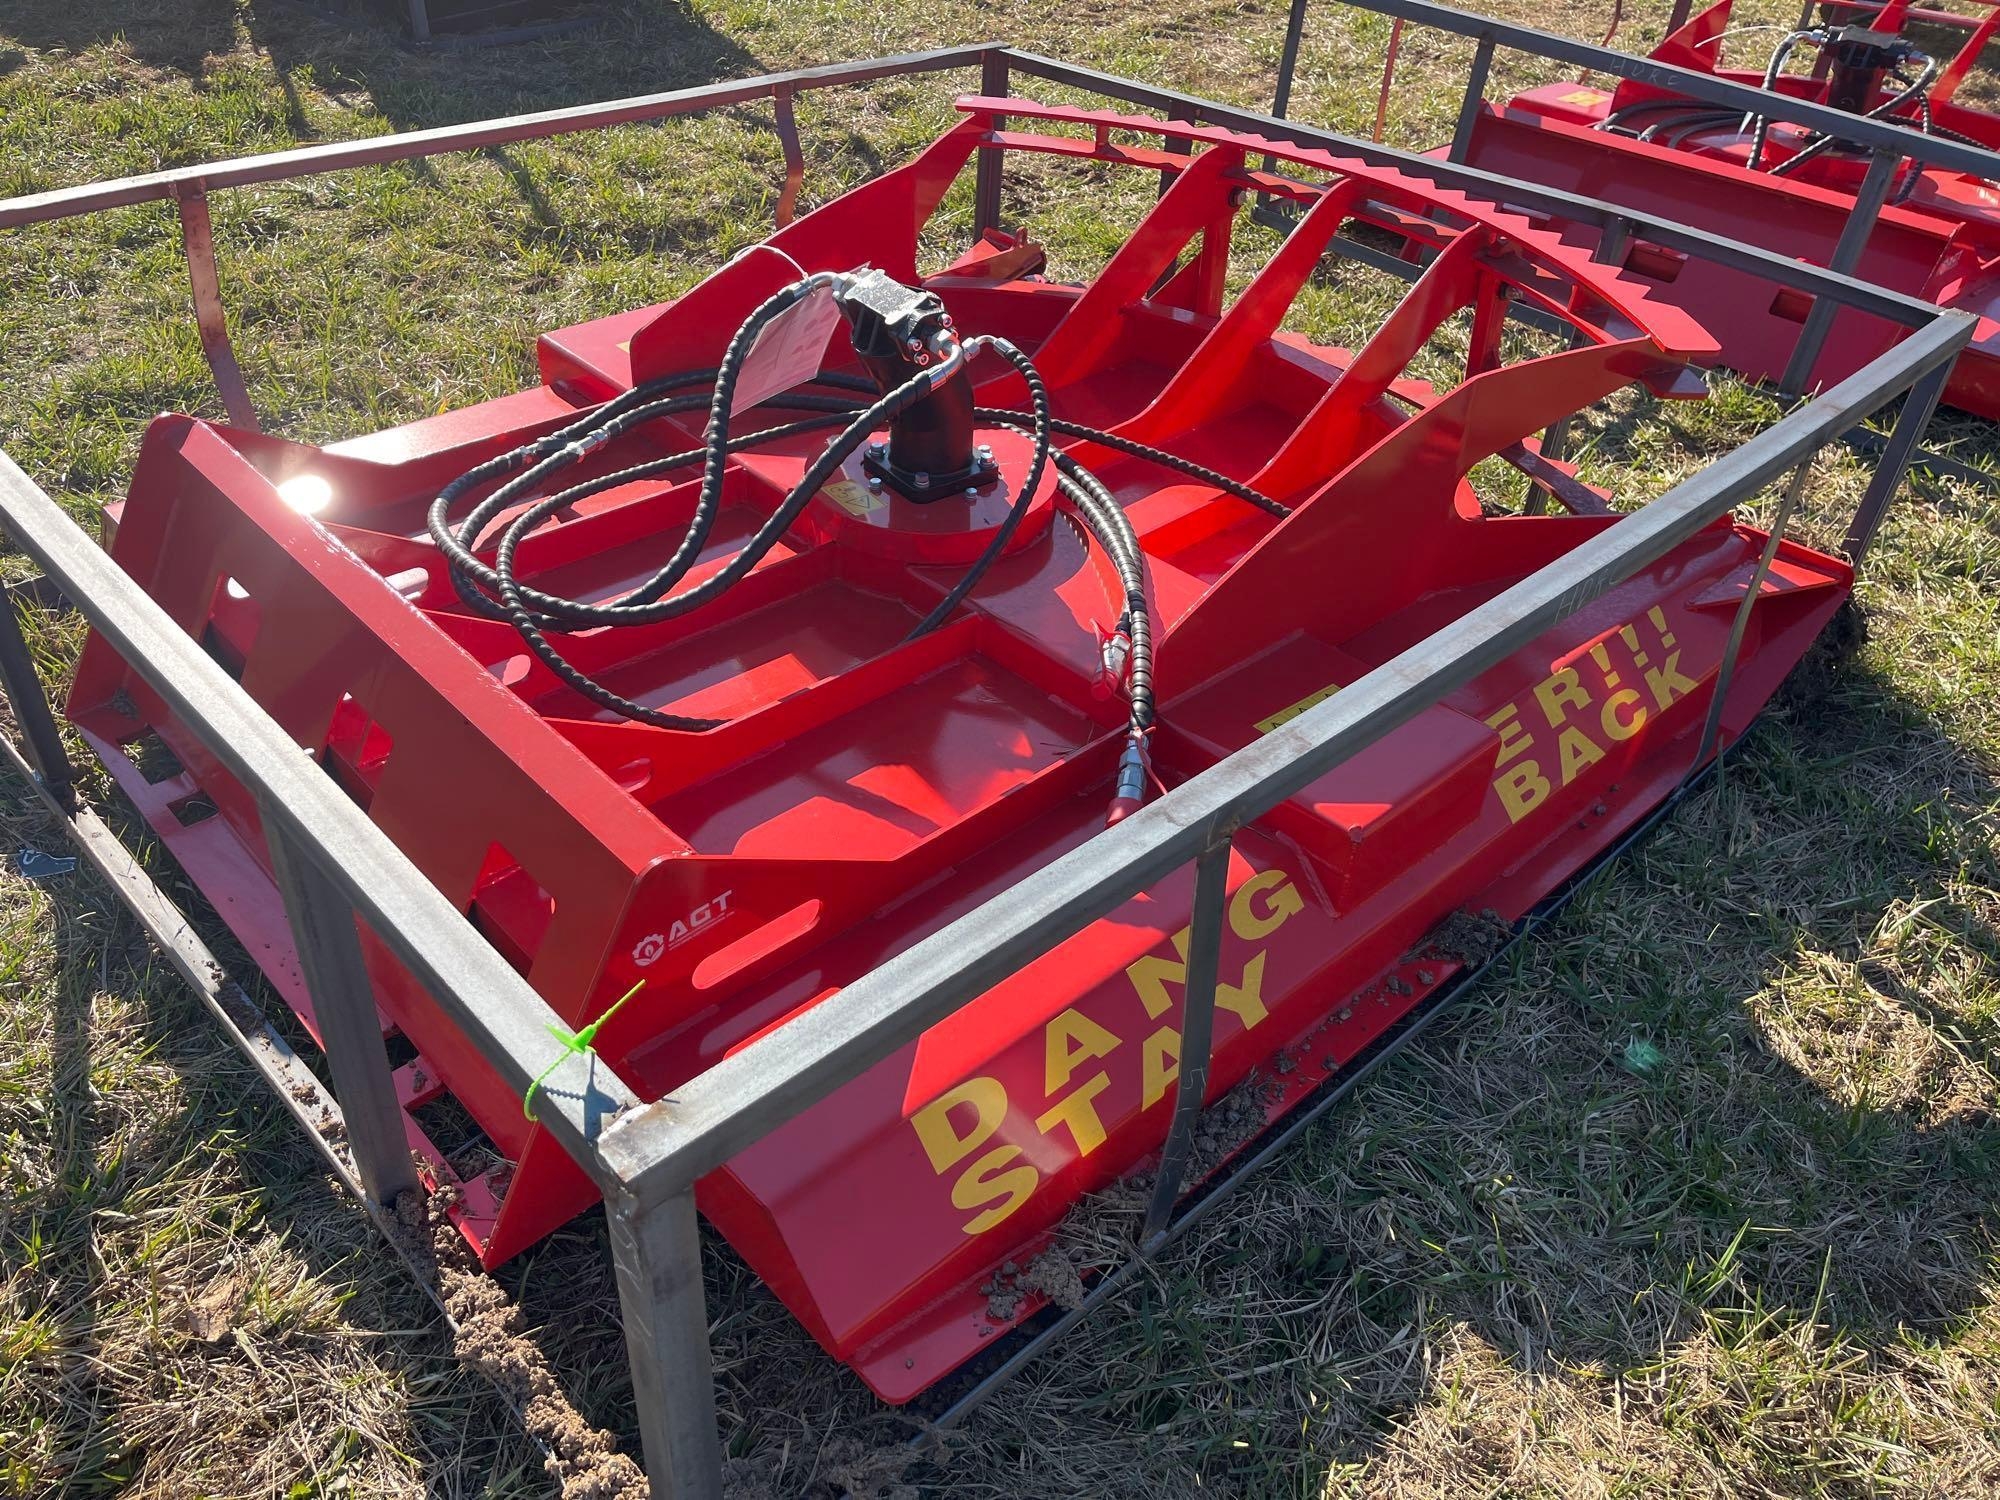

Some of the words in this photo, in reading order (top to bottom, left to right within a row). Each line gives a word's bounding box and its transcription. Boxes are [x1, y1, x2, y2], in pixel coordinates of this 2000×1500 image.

[668, 889, 732, 942] AGT
[950, 948, 1269, 1236] STAY
[1492, 648, 1699, 825] BACK
